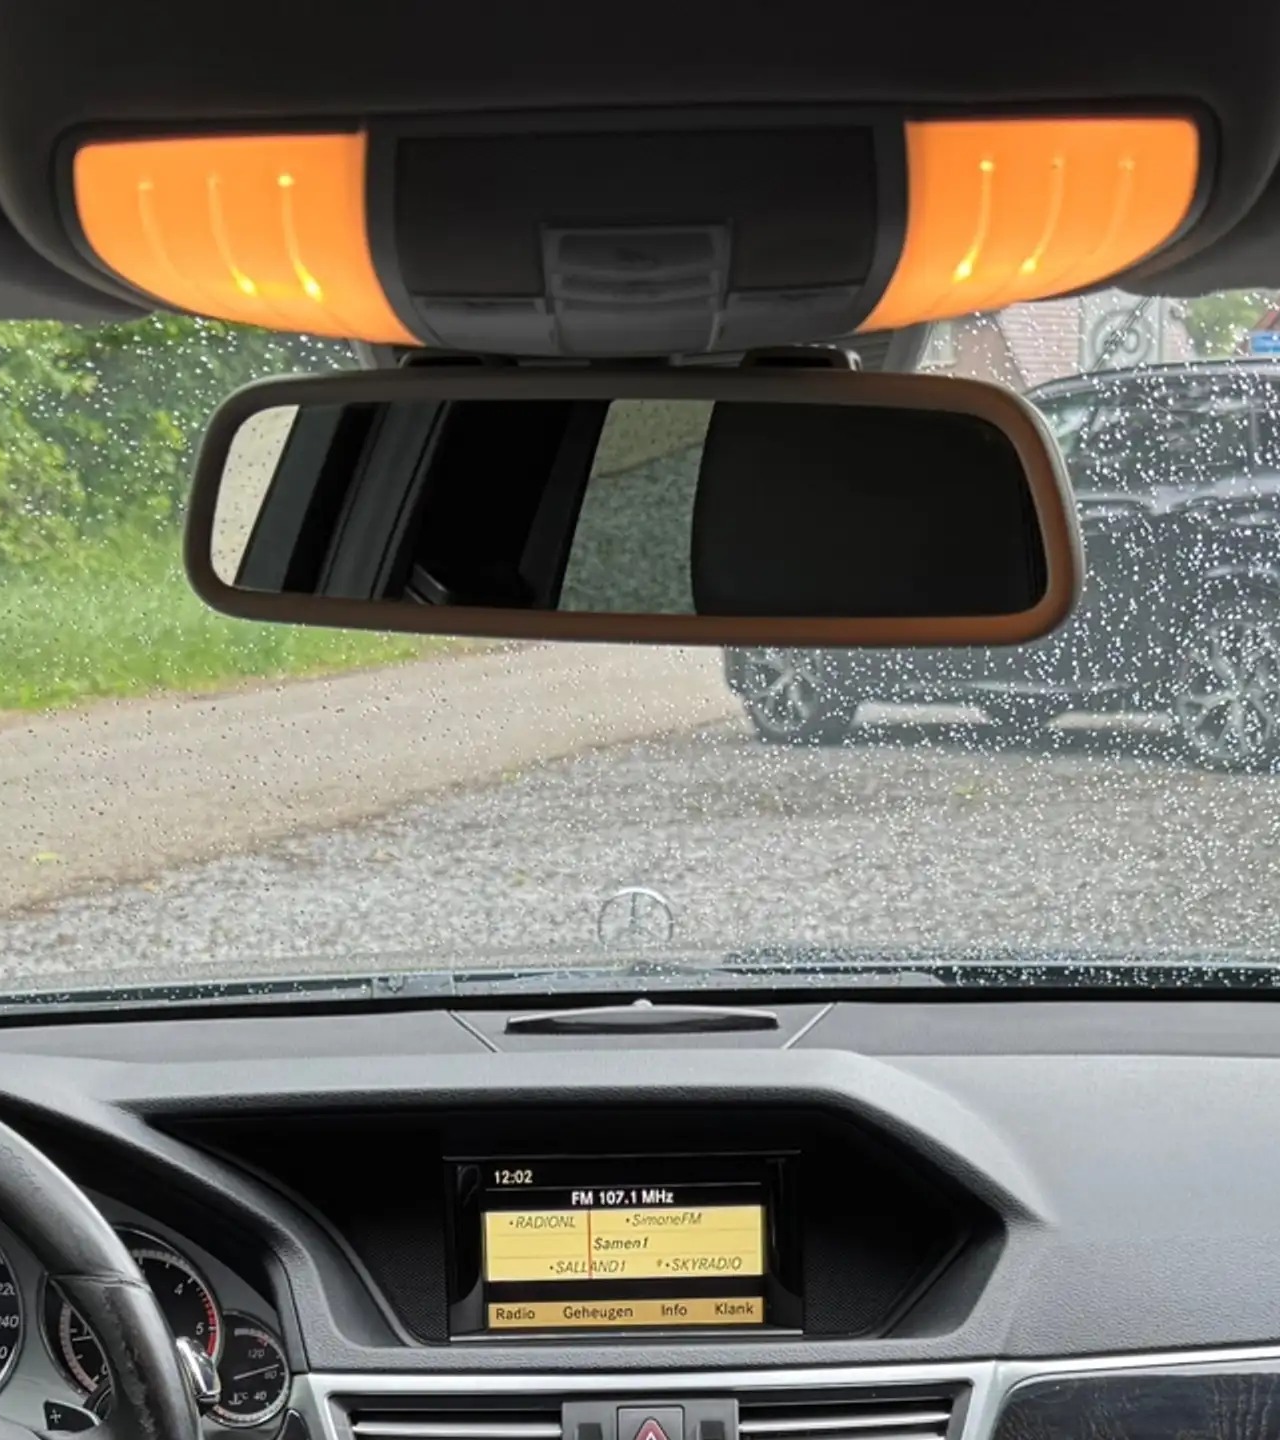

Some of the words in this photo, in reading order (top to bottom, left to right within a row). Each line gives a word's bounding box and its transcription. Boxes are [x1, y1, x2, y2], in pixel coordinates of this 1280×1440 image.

[495, 1169, 533, 1184] 12:02
[571, 1191, 593, 1205] FM
[600, 1190, 637, 1205] 107.1
[642, 1189, 674, 1204] MHz
[174, 1282, 184, 1296] 4
[496, 1307, 536, 1320] Radio
[563, 1305, 634, 1321] Geheugen
[661, 1303, 688, 1317] Info
[714, 1301, 754, 1316] Klank
[195, 1322, 204, 1336] 5
